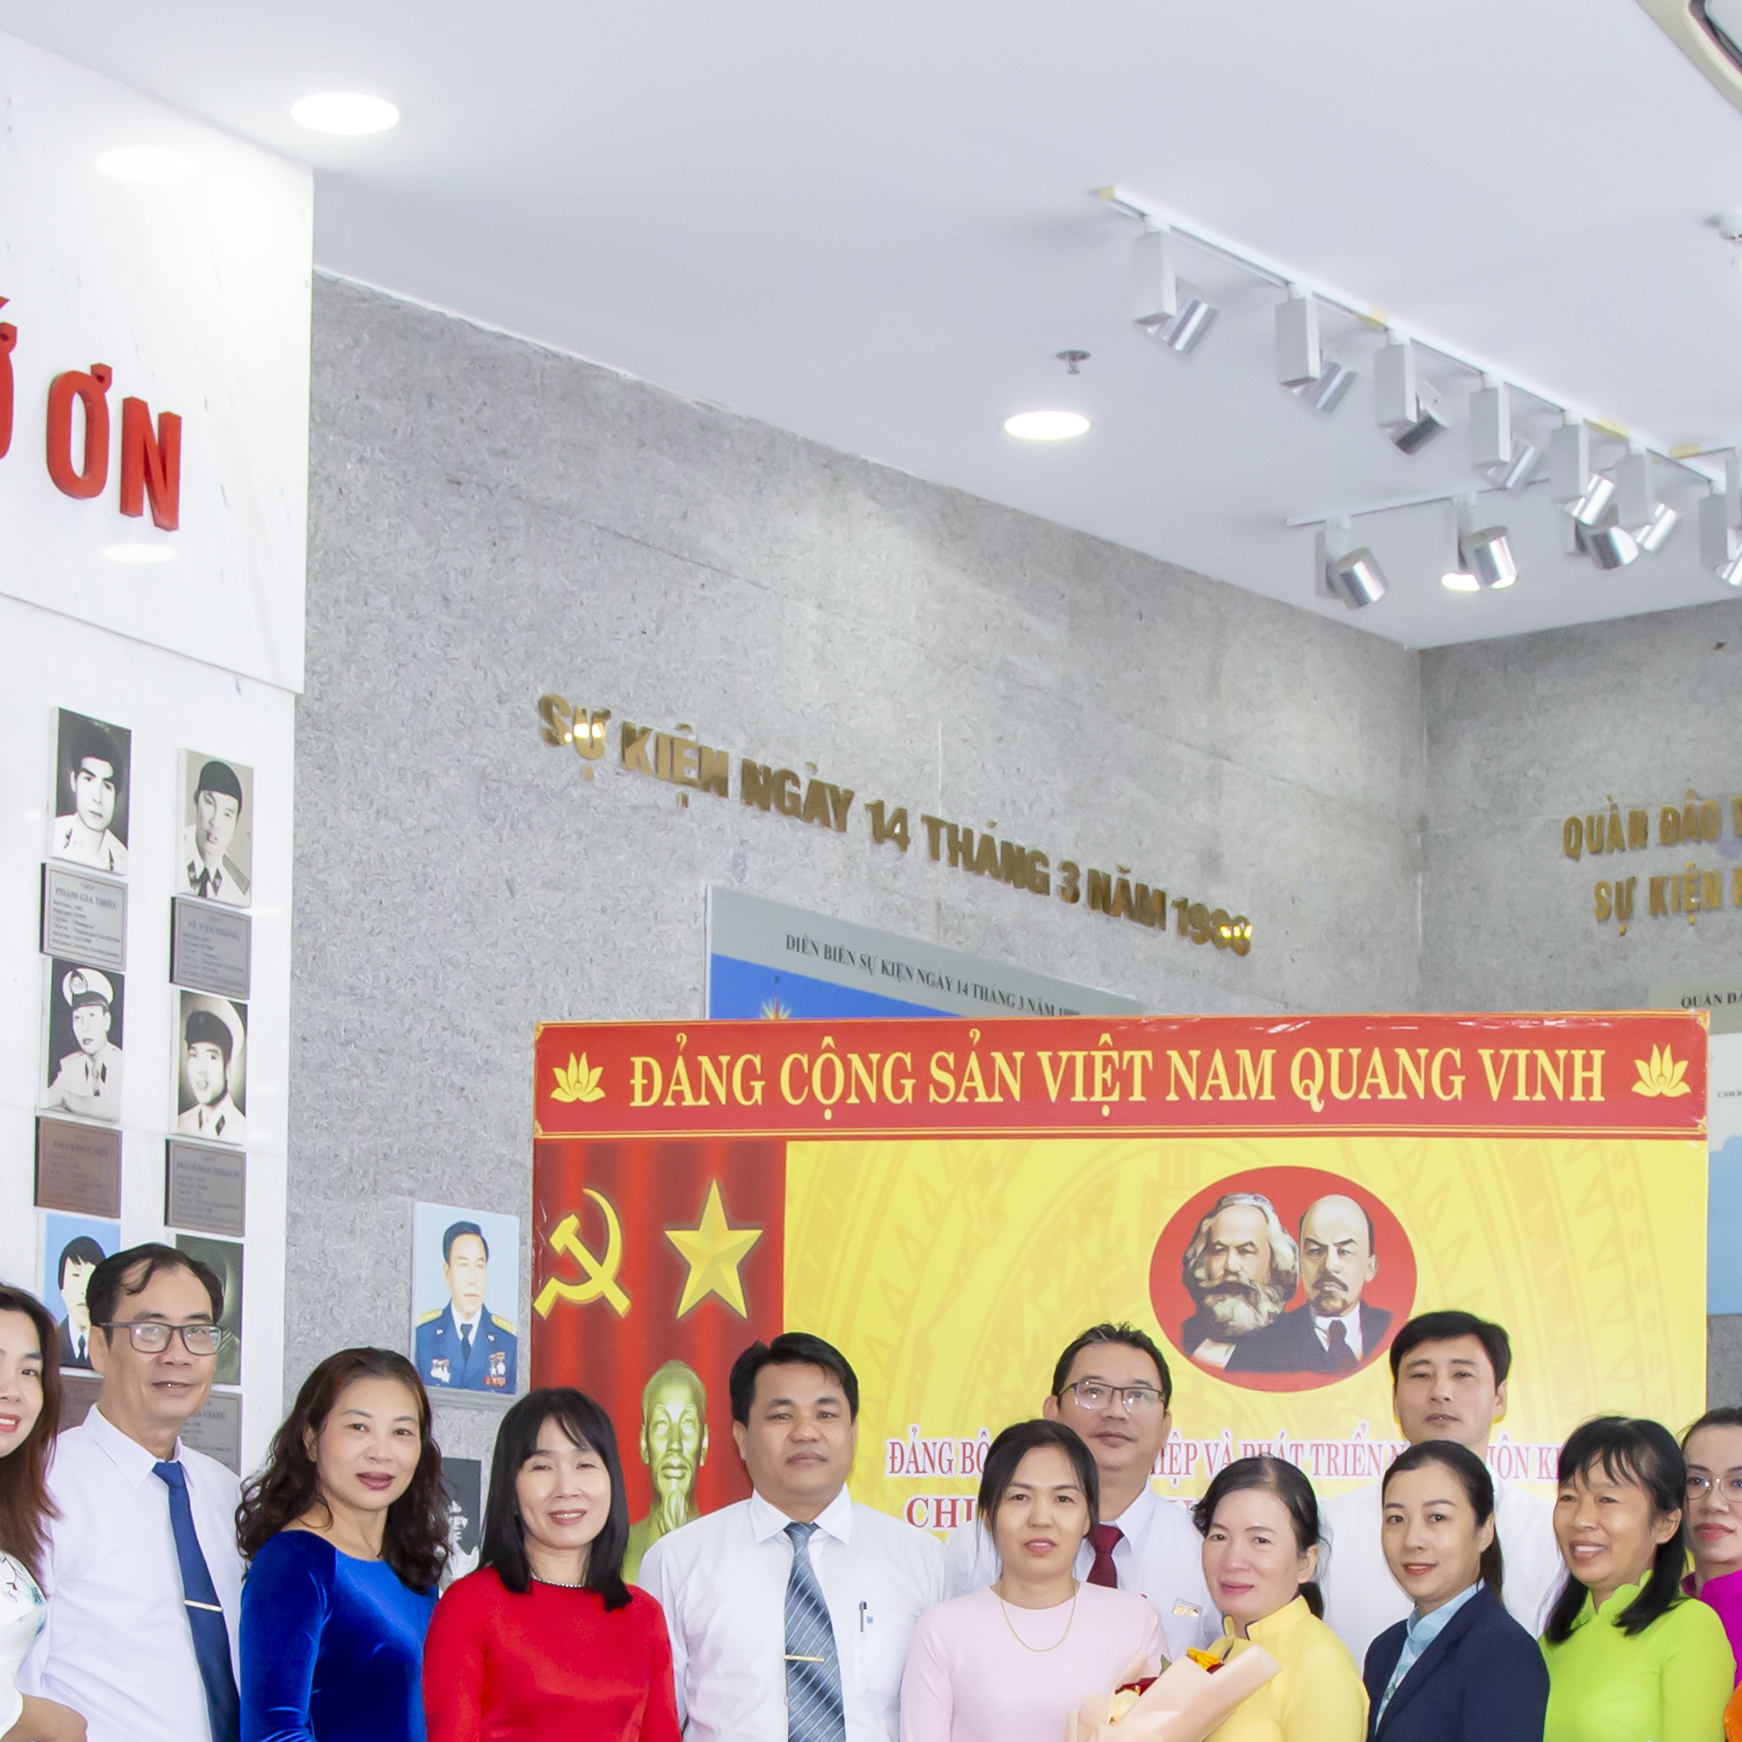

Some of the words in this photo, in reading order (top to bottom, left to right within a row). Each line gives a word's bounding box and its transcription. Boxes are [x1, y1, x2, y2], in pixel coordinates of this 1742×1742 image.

[46, 363, 183, 532] ƠN
[538, 694, 611, 781] SỰ
[621, 723, 728, 808] KIỆN
[741, 762, 855, 833] NGÀY
[865, 800, 911, 851] 14
[920, 814, 1050, 896] THÁNG
[1058, 860, 1080, 903] 3
[1087, 864, 1166, 931] NĂM
[1171, 898, 1251, 956] 1988
[1563, 794, 1648, 862] QUẦN
[1660, 788, 1719, 846] ĐẢO
[1594, 876, 1637, 936] SỰ
[1649, 861, 1721, 926] KIỆN
[629, 1032, 765, 1107] ĐẢNG
[779, 1036, 916, 1120] CỘNG
[929, 1028, 1025, 1104] SẢN
[1037, 1033, 1153, 1117] VIỆT
[1166, 1049, 1276, 1101] NAM
[1290, 1047, 1466, 1112] QUANG
[1478, 1048, 1605, 1102] VINH
[889, 1426, 953, 1474] ĐẢNG
[1204, 1432, 1234, 1475] VÀ
[1311, 1422, 1386, 1476] TRIỂN
